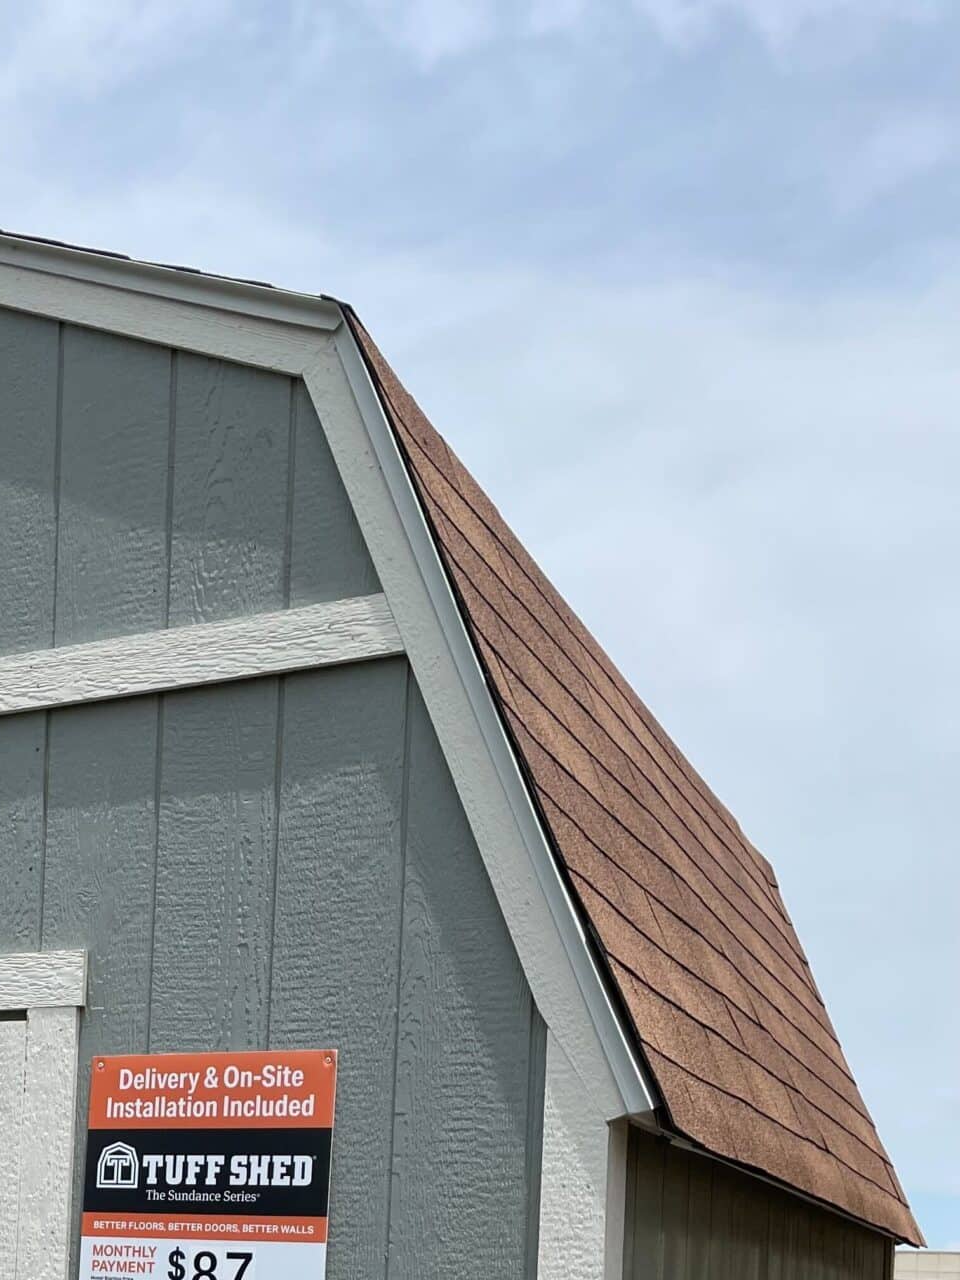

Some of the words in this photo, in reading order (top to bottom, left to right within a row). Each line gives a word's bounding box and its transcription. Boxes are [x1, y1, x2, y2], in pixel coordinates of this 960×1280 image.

[119, 1068, 200, 1094] Delivery
[204, 1066, 219, 1089] &
[224, 1065, 304, 1088] On-Site
[106, 1096, 217, 1119] Installation
[223, 1094, 315, 1117] Included
[143, 1154, 225, 1186] TUFF
[230, 1154, 313, 1186] SHED
[146, 1190, 166, 1201] The
[168, 1190, 221, 1202] Sundance
[93, 1221, 127, 1230] BETTER
[129, 1222, 166, 1232] FLOORS,
[168, 1223, 202, 1231] BETTER
[243, 1224, 278, 1234] BETTER
[281, 1226, 314, 1235] WALLS
[93, 1245, 157, 1258] MONTHLY
[92, 1260, 155, 1274] PAYMENT
